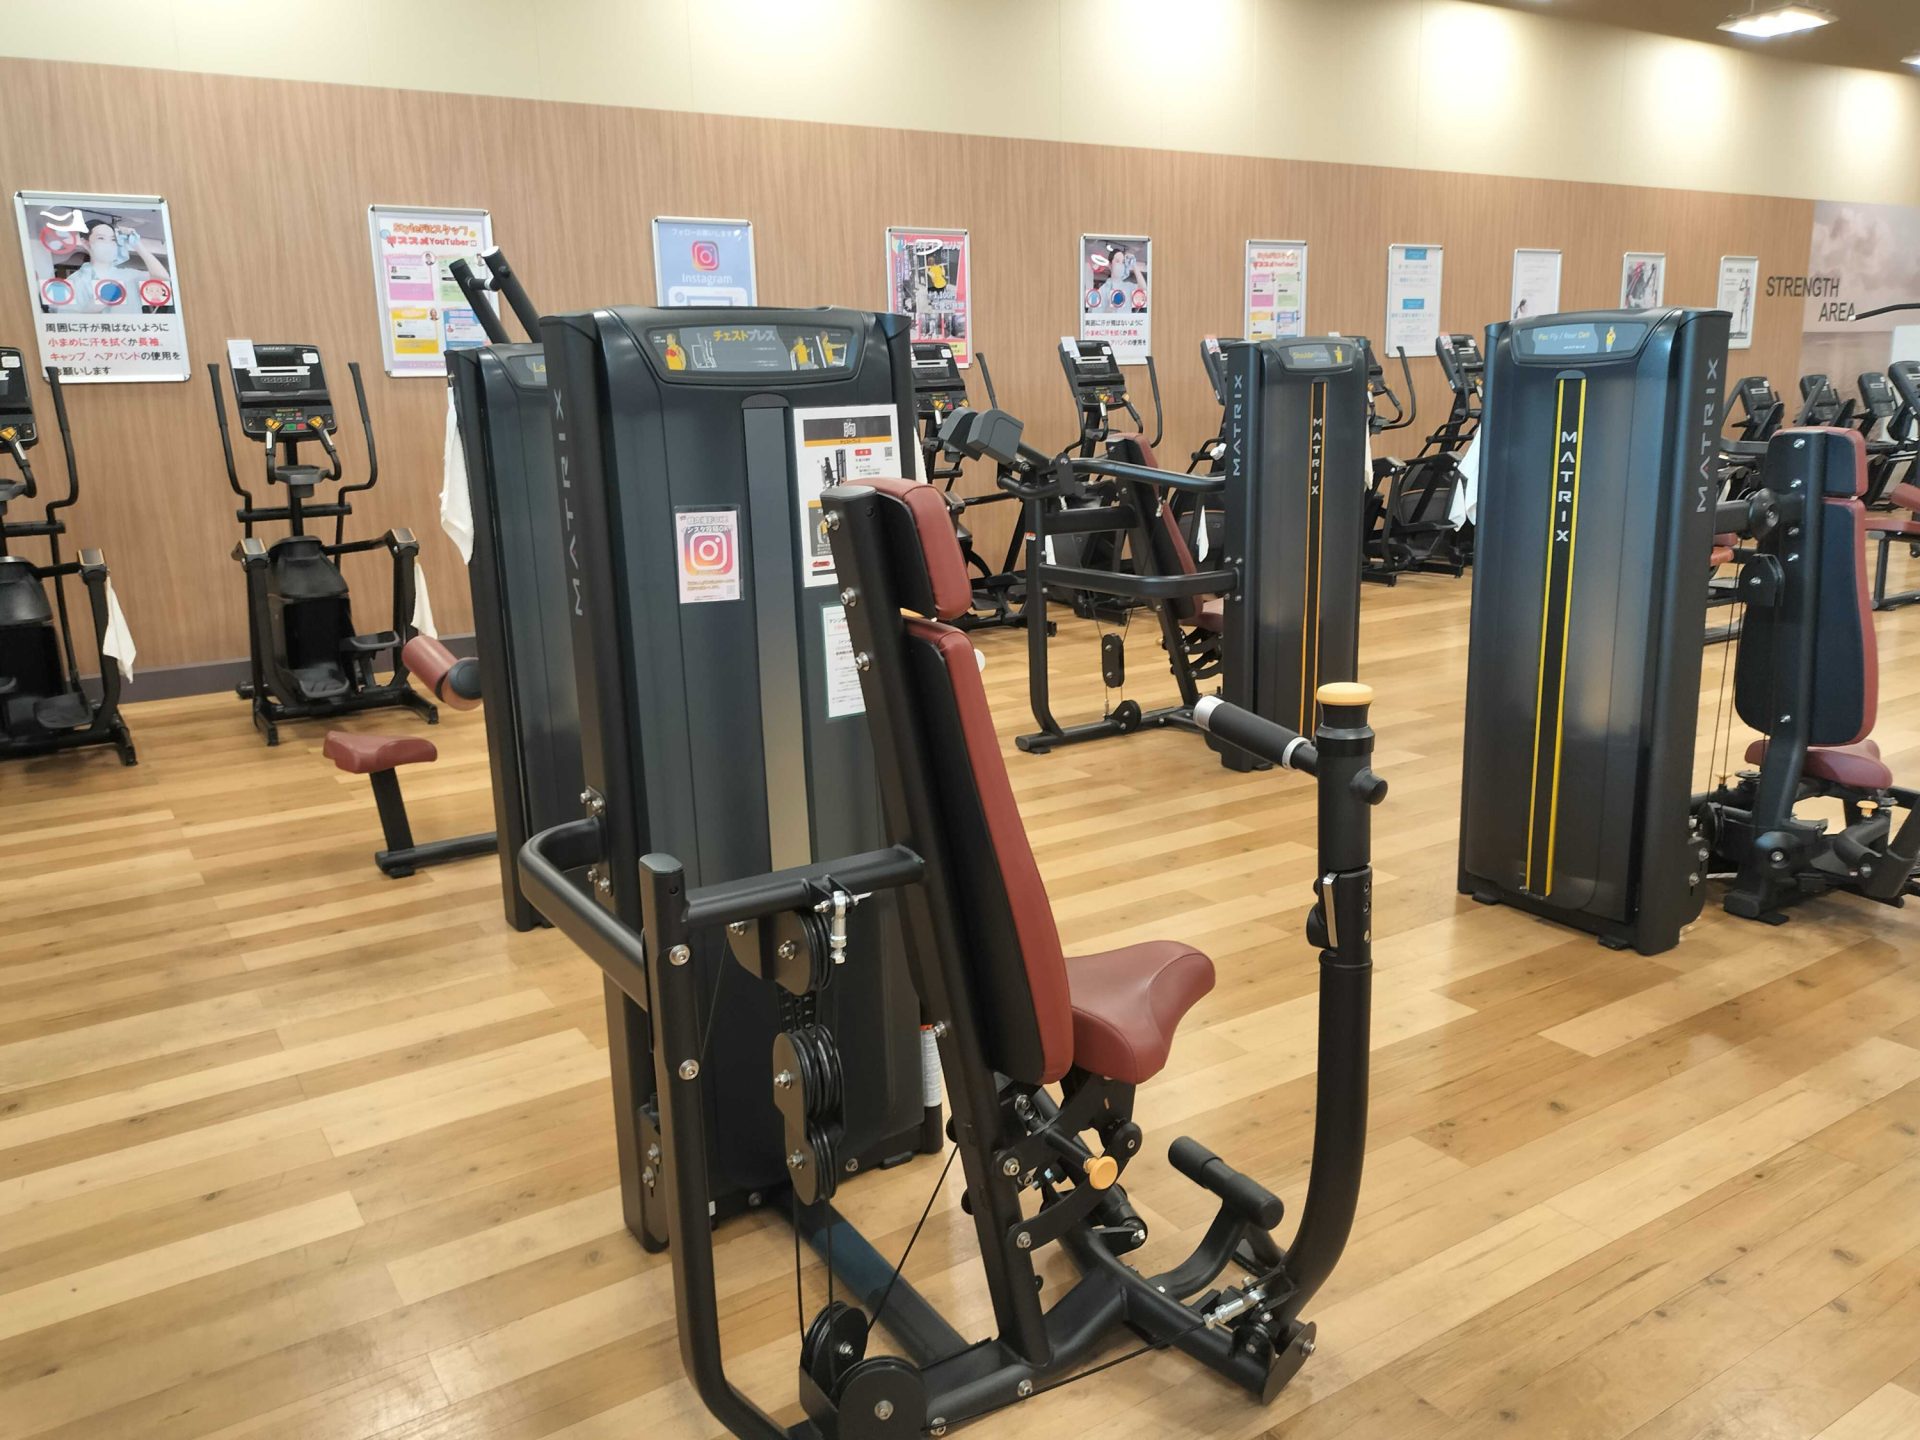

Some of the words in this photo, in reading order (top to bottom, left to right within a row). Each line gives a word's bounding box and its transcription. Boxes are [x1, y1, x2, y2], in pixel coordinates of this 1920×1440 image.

[681, 273, 733, 286] Instagram
[1766, 276, 1840, 298] STRENGTH
[1818, 303, 1855, 322] AREA
[45, 323, 169, 332] 周囲に汗が飛ばないように
[713, 329, 776, 341] チェストプレス
[843, 421, 857, 438] 胸
[1232, 374, 1243, 476] MATRIX
[1696, 358, 1718, 513] MATRIX
[1311, 418, 1323, 495] MATRIX
[1556, 431, 1578, 542] MATRIX
[553, 388, 583, 616] MATRIX
